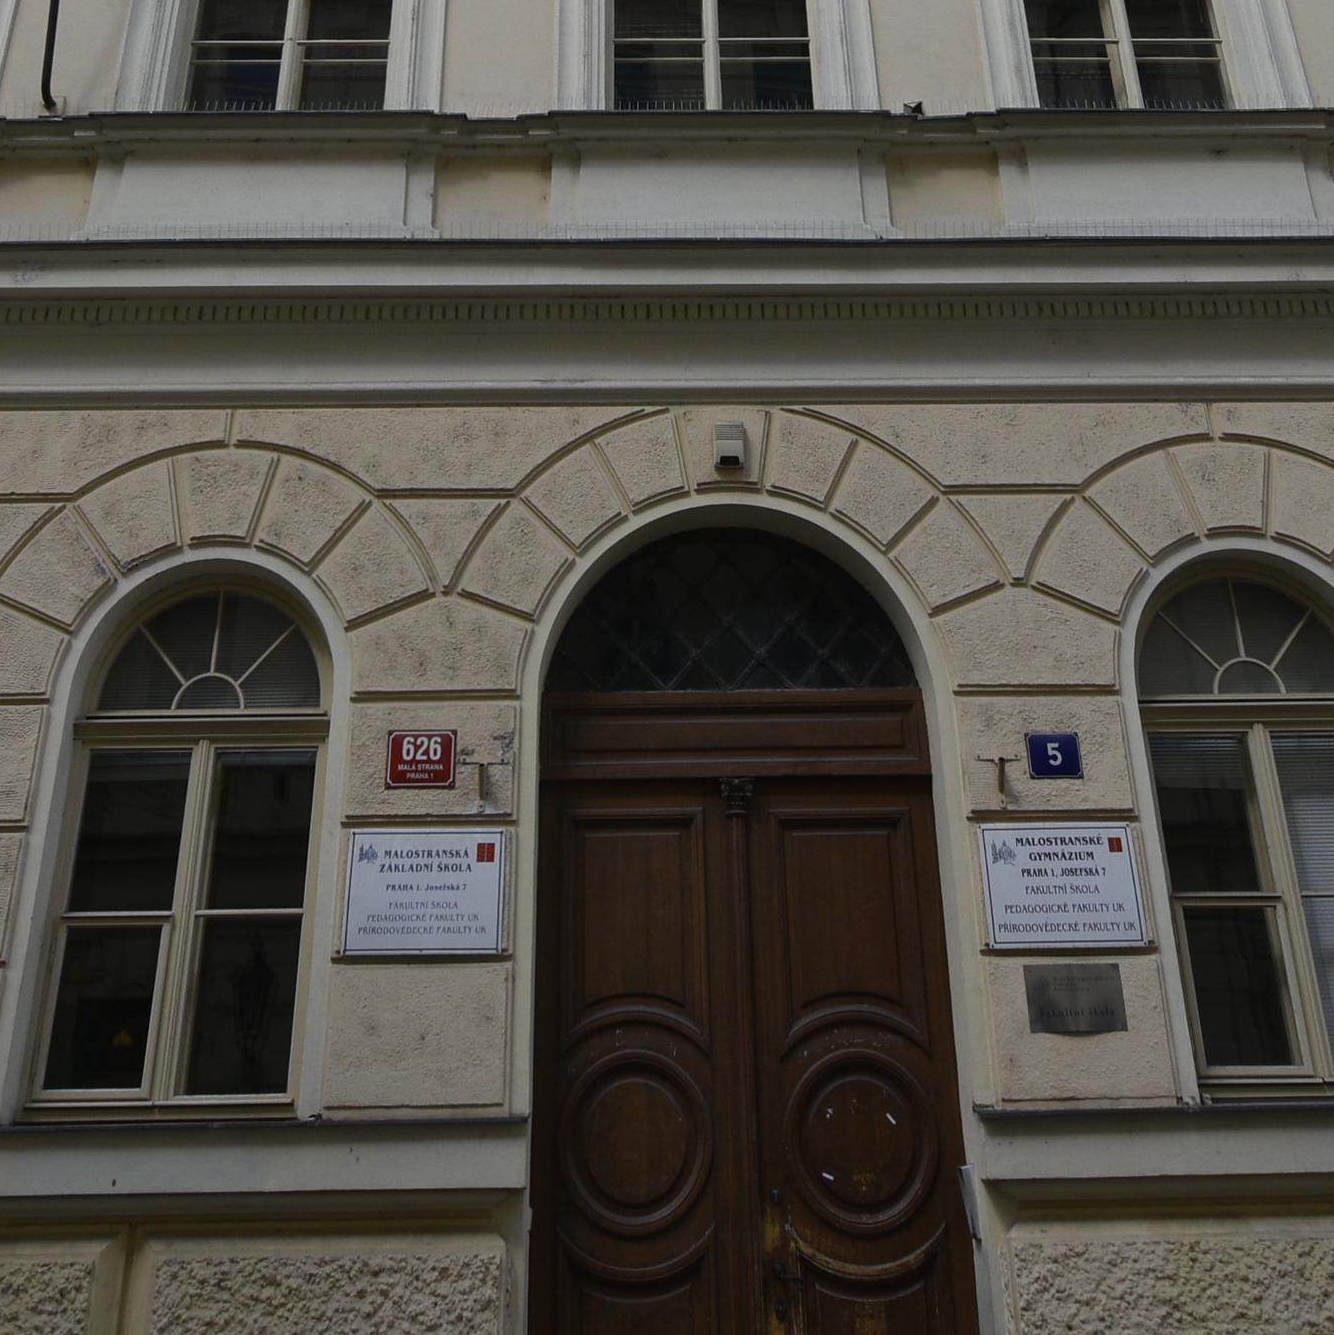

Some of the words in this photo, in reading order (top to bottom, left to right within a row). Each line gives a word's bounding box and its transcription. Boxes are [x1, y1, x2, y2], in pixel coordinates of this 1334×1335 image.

[402, 736, 442, 761] 626
[1046, 742, 1063, 767] 5
[397, 762, 416, 770] MALÁ
[1015, 834, 1103, 847] MALOSTRANSKÉ
[383, 846, 469, 859] MALOSTRANSKÁ
[1028, 848, 1095, 862] GYMNÁZIUM
[379, 861, 433, 873] ZÁKLADNÍ
[436, 861, 472, 873] ŠKOLA
[1021, 868, 1049, 878] PRAHA
[1051, 868, 1058, 878] 1,
[1059, 865, 1100, 877] JOSEFSKÁ
[1101, 867, 1106, 877] 7
[424, 883, 460, 891] Josefská
[1025, 884, 1068, 896] FAKULTNÍ
[1069, 884, 1100, 894] ŠKOLA
[388, 900, 429, 910] FAKULTNÍ
[430, 901, 459, 909] ŠKOLA
[1004, 903, 1069, 914] PEDAGOGICKÉ
[1072, 903, 1110, 913] FAKULTY
[1112, 903, 1125, 912] UK
[367, 913, 427, 923] PEDAGOGICKÉ
[429, 913, 465, 923] FAKULTY
[467, 913, 479, 922] UK
[357, 925, 434, 935] PŘÍRODOVĚDECKÉ
[436, 926, 472, 935] FAKULTY
[475, 926, 487, 934] UK
[998, 921, 1080, 933] PŘÍRODOVĚDECKÉ
[1083, 923, 1121, 932] FAKULTY
[1123, 922, 1137, 931] UK
